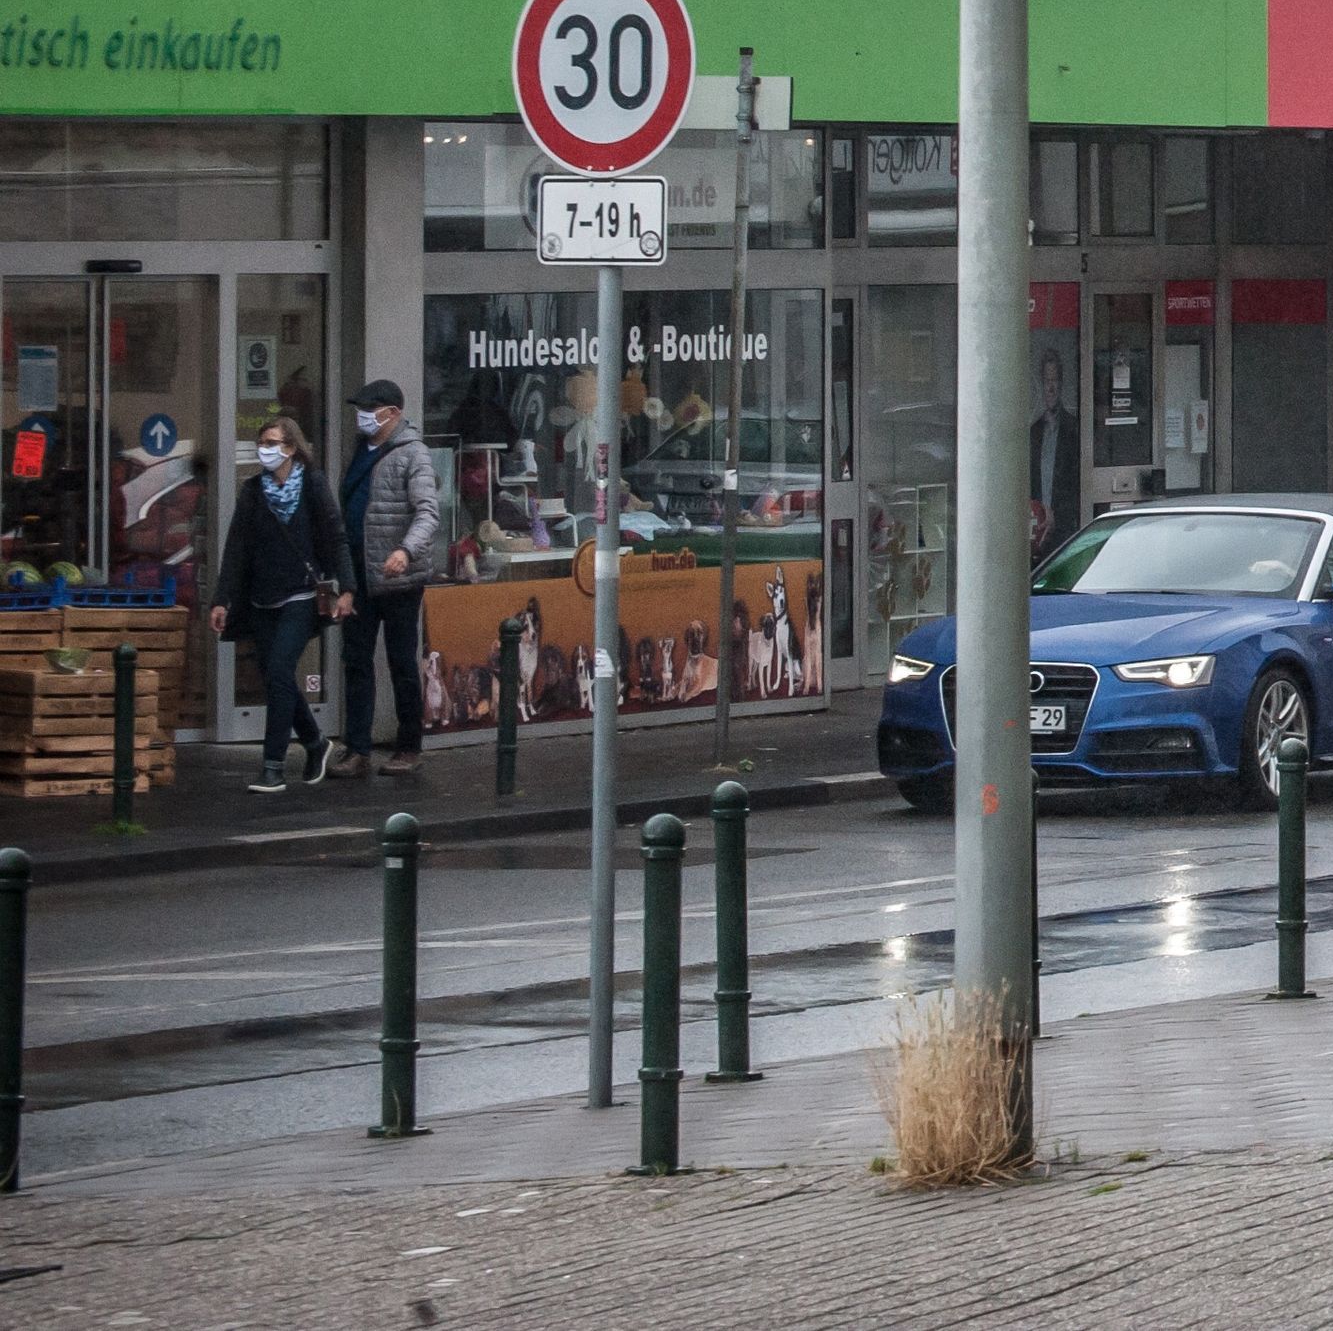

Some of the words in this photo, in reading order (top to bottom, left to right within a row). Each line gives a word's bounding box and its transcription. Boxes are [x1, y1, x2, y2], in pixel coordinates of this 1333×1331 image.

[104, 16, 282, 71] einkaufen
[553, 14, 654, 111] 30
[469, 328, 599, 368] Hundesalo
[626, 325, 645, 363] &
[1042, 708, 1063, 727] 29
